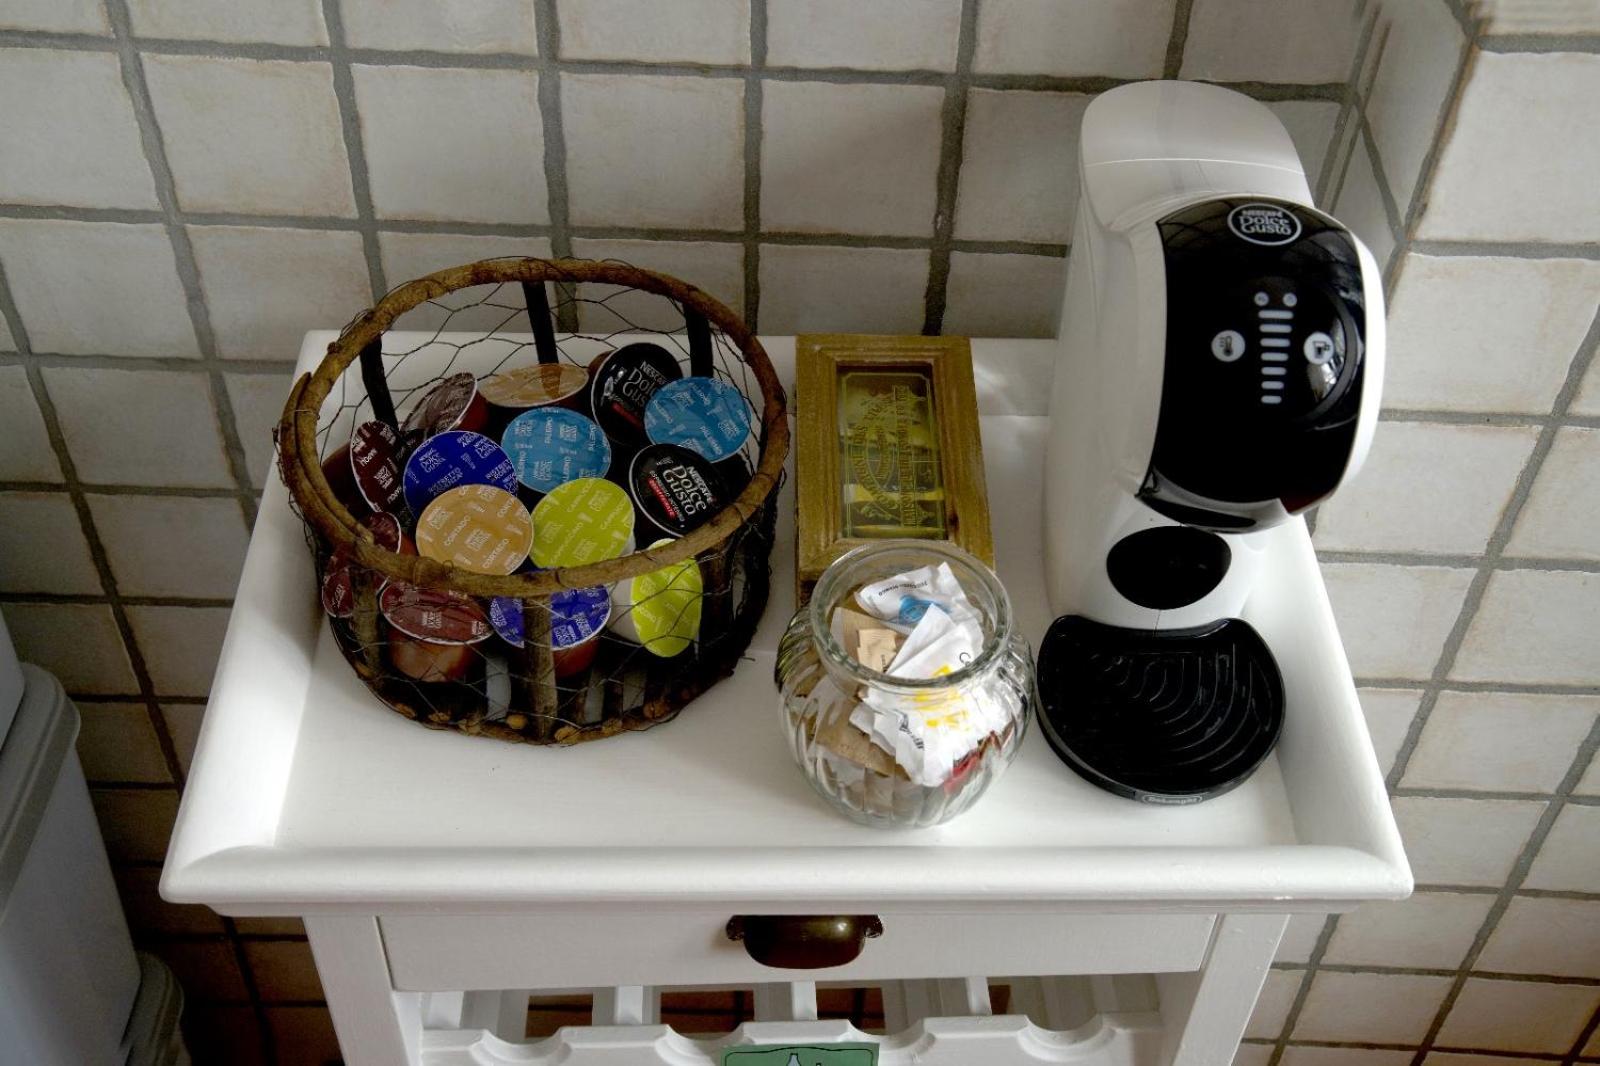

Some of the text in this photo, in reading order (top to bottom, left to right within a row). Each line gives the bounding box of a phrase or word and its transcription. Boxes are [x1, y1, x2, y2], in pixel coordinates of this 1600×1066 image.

[1239, 215, 1290, 227] Dolce
[1240, 223, 1292, 236] Gusto
[622, 381, 648, 407] Gus
[662, 469, 696, 516] Gusto
[672, 465, 707, 511] Dolce
